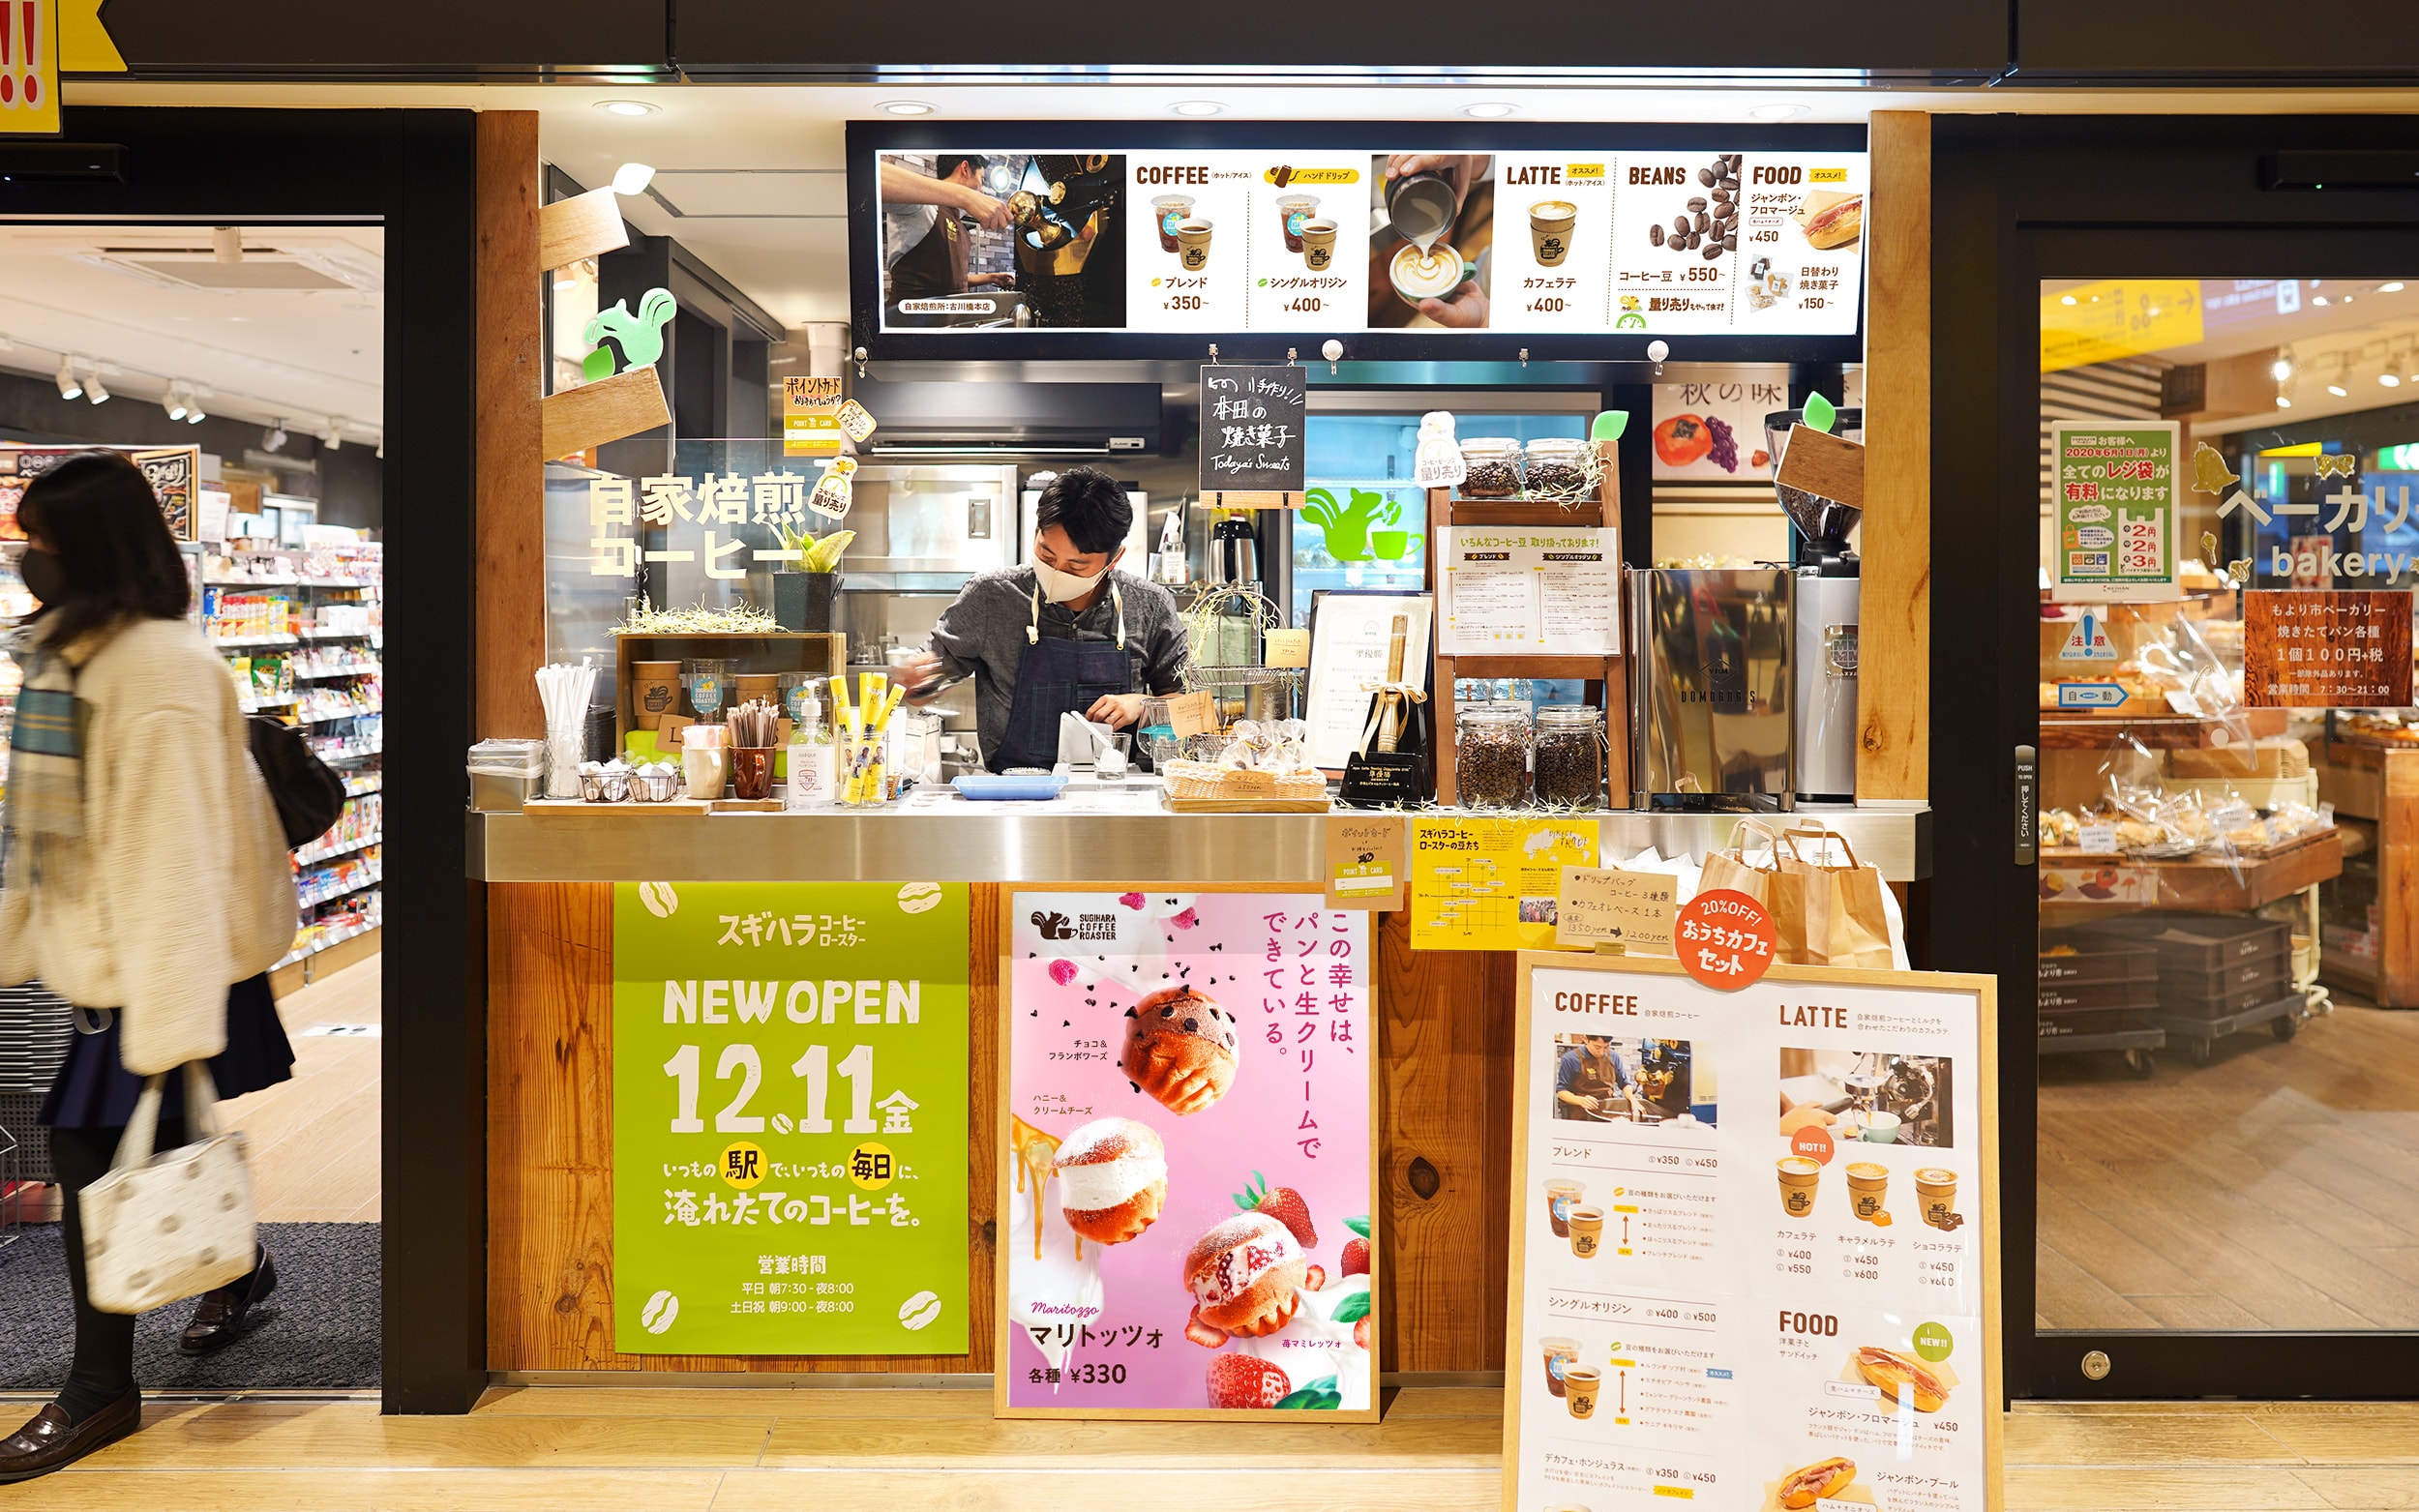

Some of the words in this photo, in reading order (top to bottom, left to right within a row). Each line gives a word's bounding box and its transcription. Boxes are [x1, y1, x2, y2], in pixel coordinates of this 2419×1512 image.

[1136, 166, 1210, 186] COFFEE
[1507, 166, 1561, 185] LATTE
[1571, 166, 1598, 176] オススメ!
[1629, 166, 1686, 185] BEANS
[1753, 166, 1802, 185] FOOD
[1813, 171, 1841, 180] オススメ!
[1750, 206, 1806, 216] フロマージュ
[1748, 230, 1778, 242] ¥450
[1619, 271, 1673, 282] コーヒー豆
[1802, 267, 1839, 277] 日替わり
[1165, 277, 1209, 289] ブレンド
[1269, 277, 1348, 289] シングルオリジン
[1523, 277, 1576, 288] カフェラテ
[1800, 280, 1839, 290] 焼き菓子
[787, 378, 841, 395] ポイントカード
[1680, 383, 1783, 406] 秋の味
[1212, 395, 1268, 421] 本田の
[1221, 423, 1297, 449] 焼き菓子
[1420, 465, 1462, 482] 量り売り
[2063, 460, 2169, 480] 全てのレジ袋が
[589, 471, 806, 526] 自家焙煎
[2065, 482, 2168, 502] 有料になります
[812, 493, 847, 514] 量り売り
[2216, 486, 2419, 534] ベーカリ
[2133, 524, 2157, 538] 2円
[1460, 537, 1527, 548] いろんなコーヒー豆
[2133, 540, 2157, 553] 2円
[590, 530, 804, 579] コーヒー
[2133, 555, 2157, 568] 3円
[2272, 546, 2405, 584] bakery
[2273, 604, 2386, 616] もより市ベーカリー
[2278, 625, 2380, 638] 焼きたてパン各種
[2268, 684, 2310, 695] 営業時間
[1419, 829, 1474, 839] スギハラコーヒー
[1419, 841, 1479, 850] ロースターの豆たち
[1560, 837, 1589, 849] TRADE
[1609, 890, 1639, 899] コーヒー
[1577, 900, 1640, 916] カフェオレベース
[1700, 898, 1763, 928] 20%OFF!
[1079, 914, 1117, 923] SUGIHARA
[717, 910, 817, 947] スギハラ
[820, 914, 867, 932] コーヒー
[1079, 923, 1117, 932] COFFEE
[820, 934, 867, 947] ロースター
[1079, 932, 1117, 940] ROASTER
[1681, 918, 1770, 958] おうちカフェ
[1698, 949, 1745, 977] セット
[1263, 911, 1288, 1055] できている。
[1328, 912, 1355, 1054] この幸せは、
[663, 979, 780, 1025] NEW
[785, 979, 920, 1025] OPEN
[1555, 992, 1639, 1017] COFFEE
[1779, 1004, 1848, 1028] LATTE
[1295, 911, 1322, 1159] パンと生クリームで
[1073, 1039, 1108, 1049] チョコ&
[1049, 1052, 1108, 1061] フランボワーズ
[1033, 1106, 1092, 1115] クリームチーズ
[1552, 1146, 1592, 1159] ブレンド
[1657, 1155, 1680, 1166] ¥350
[1695, 1158, 1718, 1169] ¥450
[663, 1188, 921, 1228] 淹れたてのコーヒーを。
[1777, 1230, 1817, 1241] カフェラテ
[1837, 1234, 1896, 1248] キャラメルラテ
[1912, 1241, 1962, 1254] ショコララテ
[1788, 1250, 1811, 1260] ¥400
[1854, 1256, 1878, 1265] ¥450
[758, 1255, 827, 1275] 営業時間
[1788, 1264, 1811, 1274] ¥550
[1929, 1261, 1955, 1272] ¥450
[1854, 1270, 1878, 1280] ¥600
[741, 1283, 764, 1295] 平日
[731, 1301, 765, 1314] 土日祝
[1030, 1301, 1100, 1319] Maritozzo
[1548, 1296, 1632, 1315] シングルオリジン
[1656, 1309, 1679, 1319] ¥400
[1693, 1312, 1717, 1322] ¥500
[1778, 1311, 1838, 1337] FOOD
[1029, 1323, 1164, 1349] マリトッツォ
[1282, 1339, 1342, 1349] 苺マミレッツォ
[1920, 1337, 1949, 1349] NEW!!
[1779, 1350, 1819, 1361] サンドイッチ
[1029, 1367, 1061, 1384] 各種
[1070, 1363, 1127, 1384] ¥330
[1933, 1421, 1959, 1433] ¥450
[1656, 1468, 1679, 1479] ¥350
[1692, 1473, 1717, 1484] ¥450
